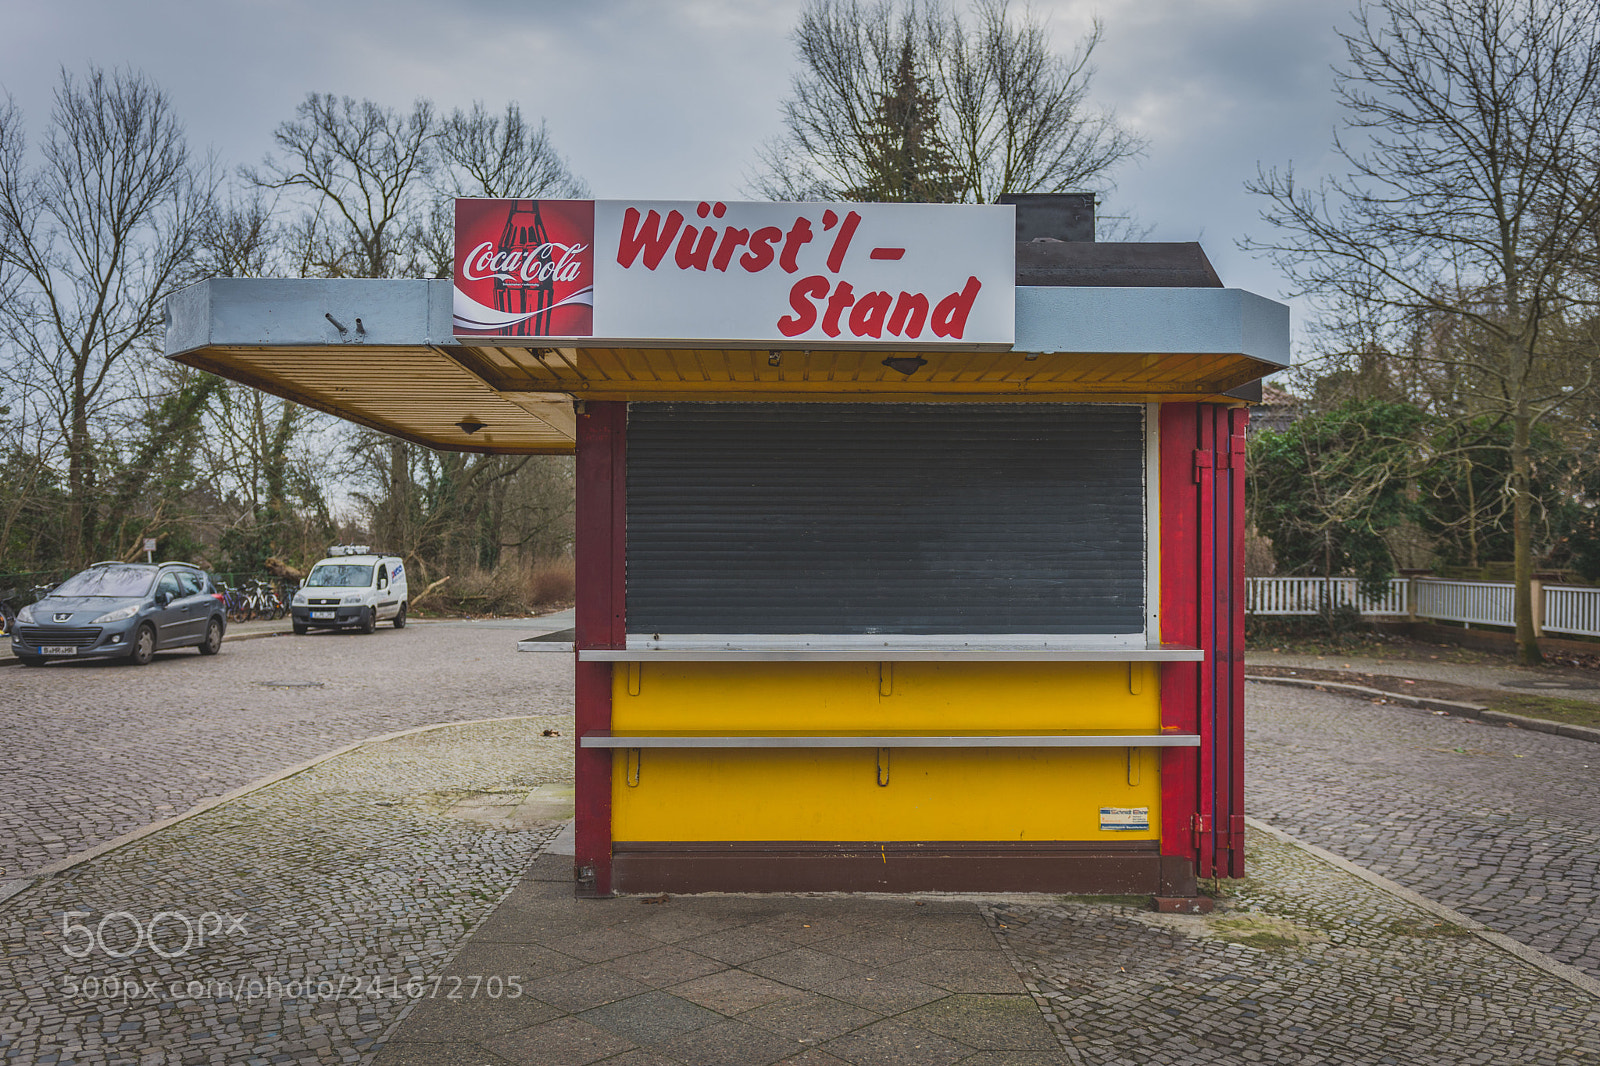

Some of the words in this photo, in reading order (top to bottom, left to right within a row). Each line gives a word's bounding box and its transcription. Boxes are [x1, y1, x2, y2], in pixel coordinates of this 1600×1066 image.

[462, 241, 589, 282] Coca-Cola
[616, 201, 862, 274] Würst'l
[776, 275, 982, 340] Stand
